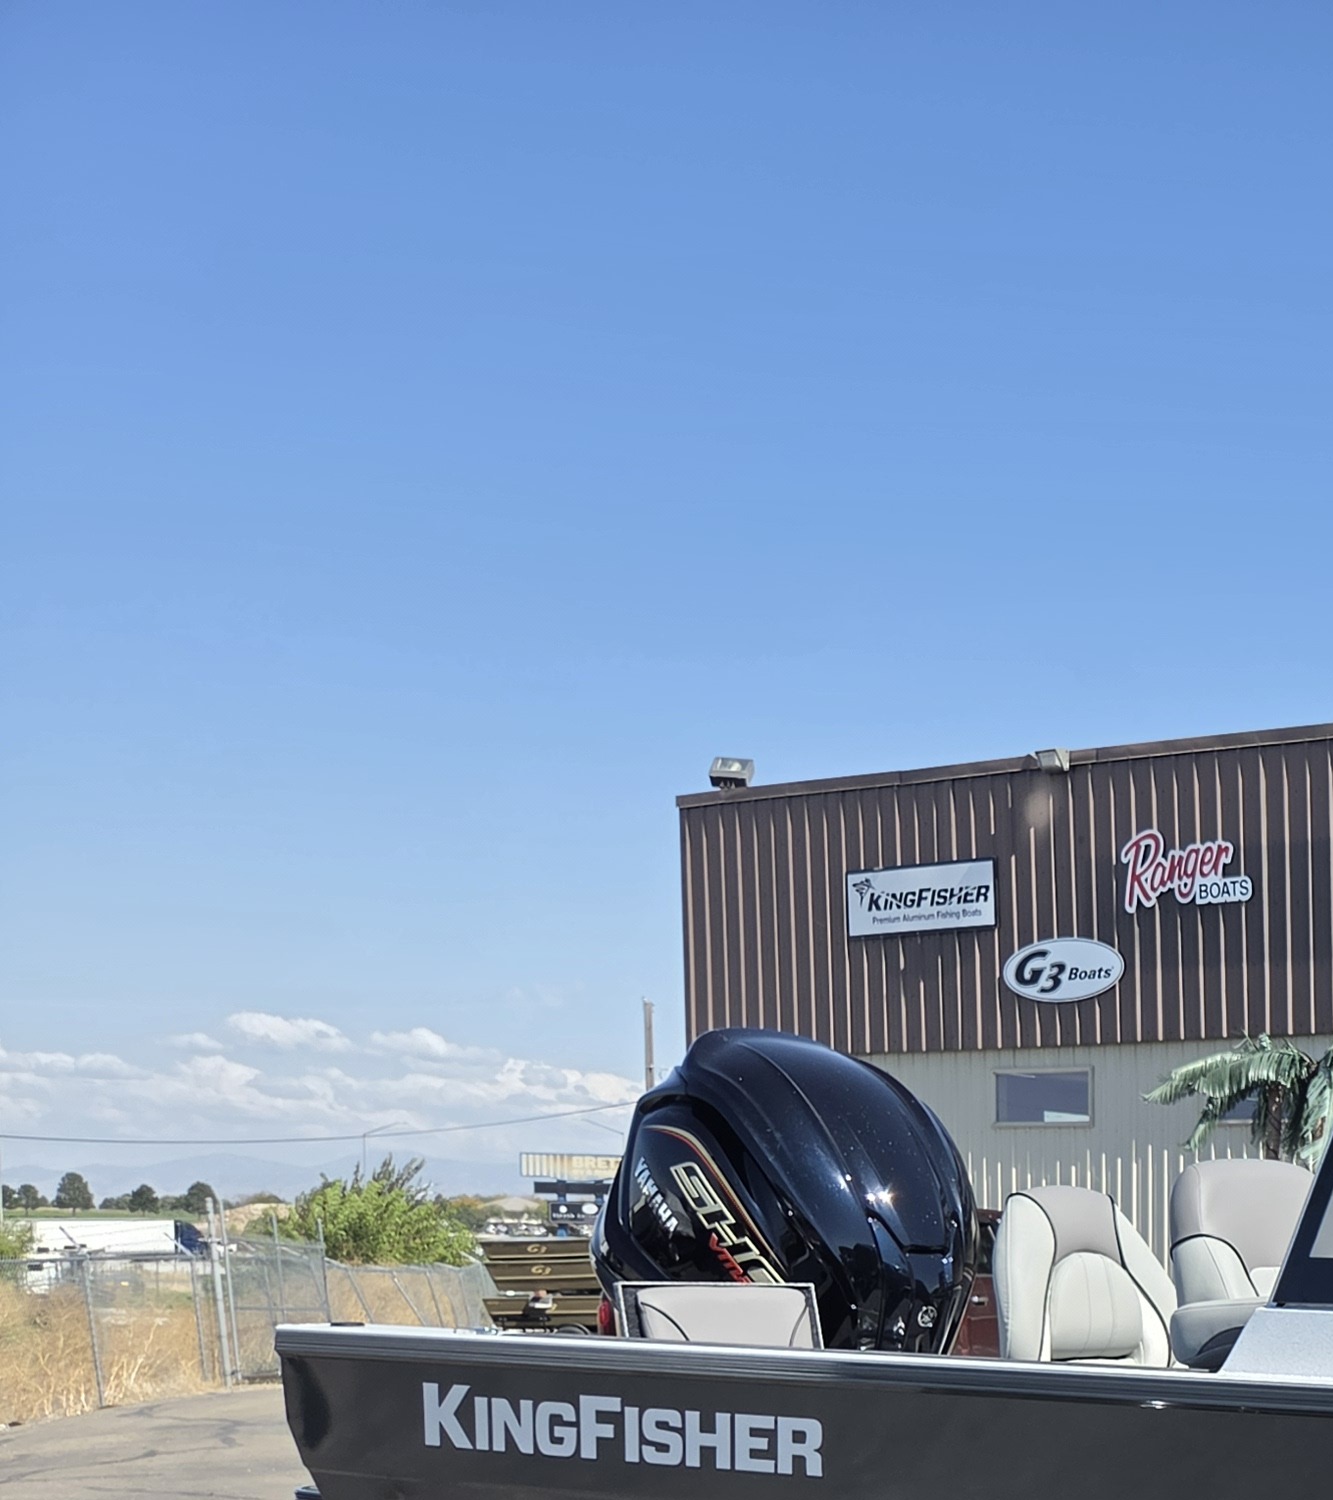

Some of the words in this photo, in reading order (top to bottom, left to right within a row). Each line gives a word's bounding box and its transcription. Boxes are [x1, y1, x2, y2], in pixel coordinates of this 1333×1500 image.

[1124, 832, 1231, 908] Ranger
[1199, 879, 1250, 900] BOATS
[872, 913, 900, 925] Premium
[902, 911, 935, 923] Aluminum
[936, 908, 960, 920] Fishing
[962, 906, 982, 918] Boats
[1015, 949, 1066, 994] G3
[1068, 966, 1112, 981] Boats
[634, 1156, 679, 1234] YAMAHA
